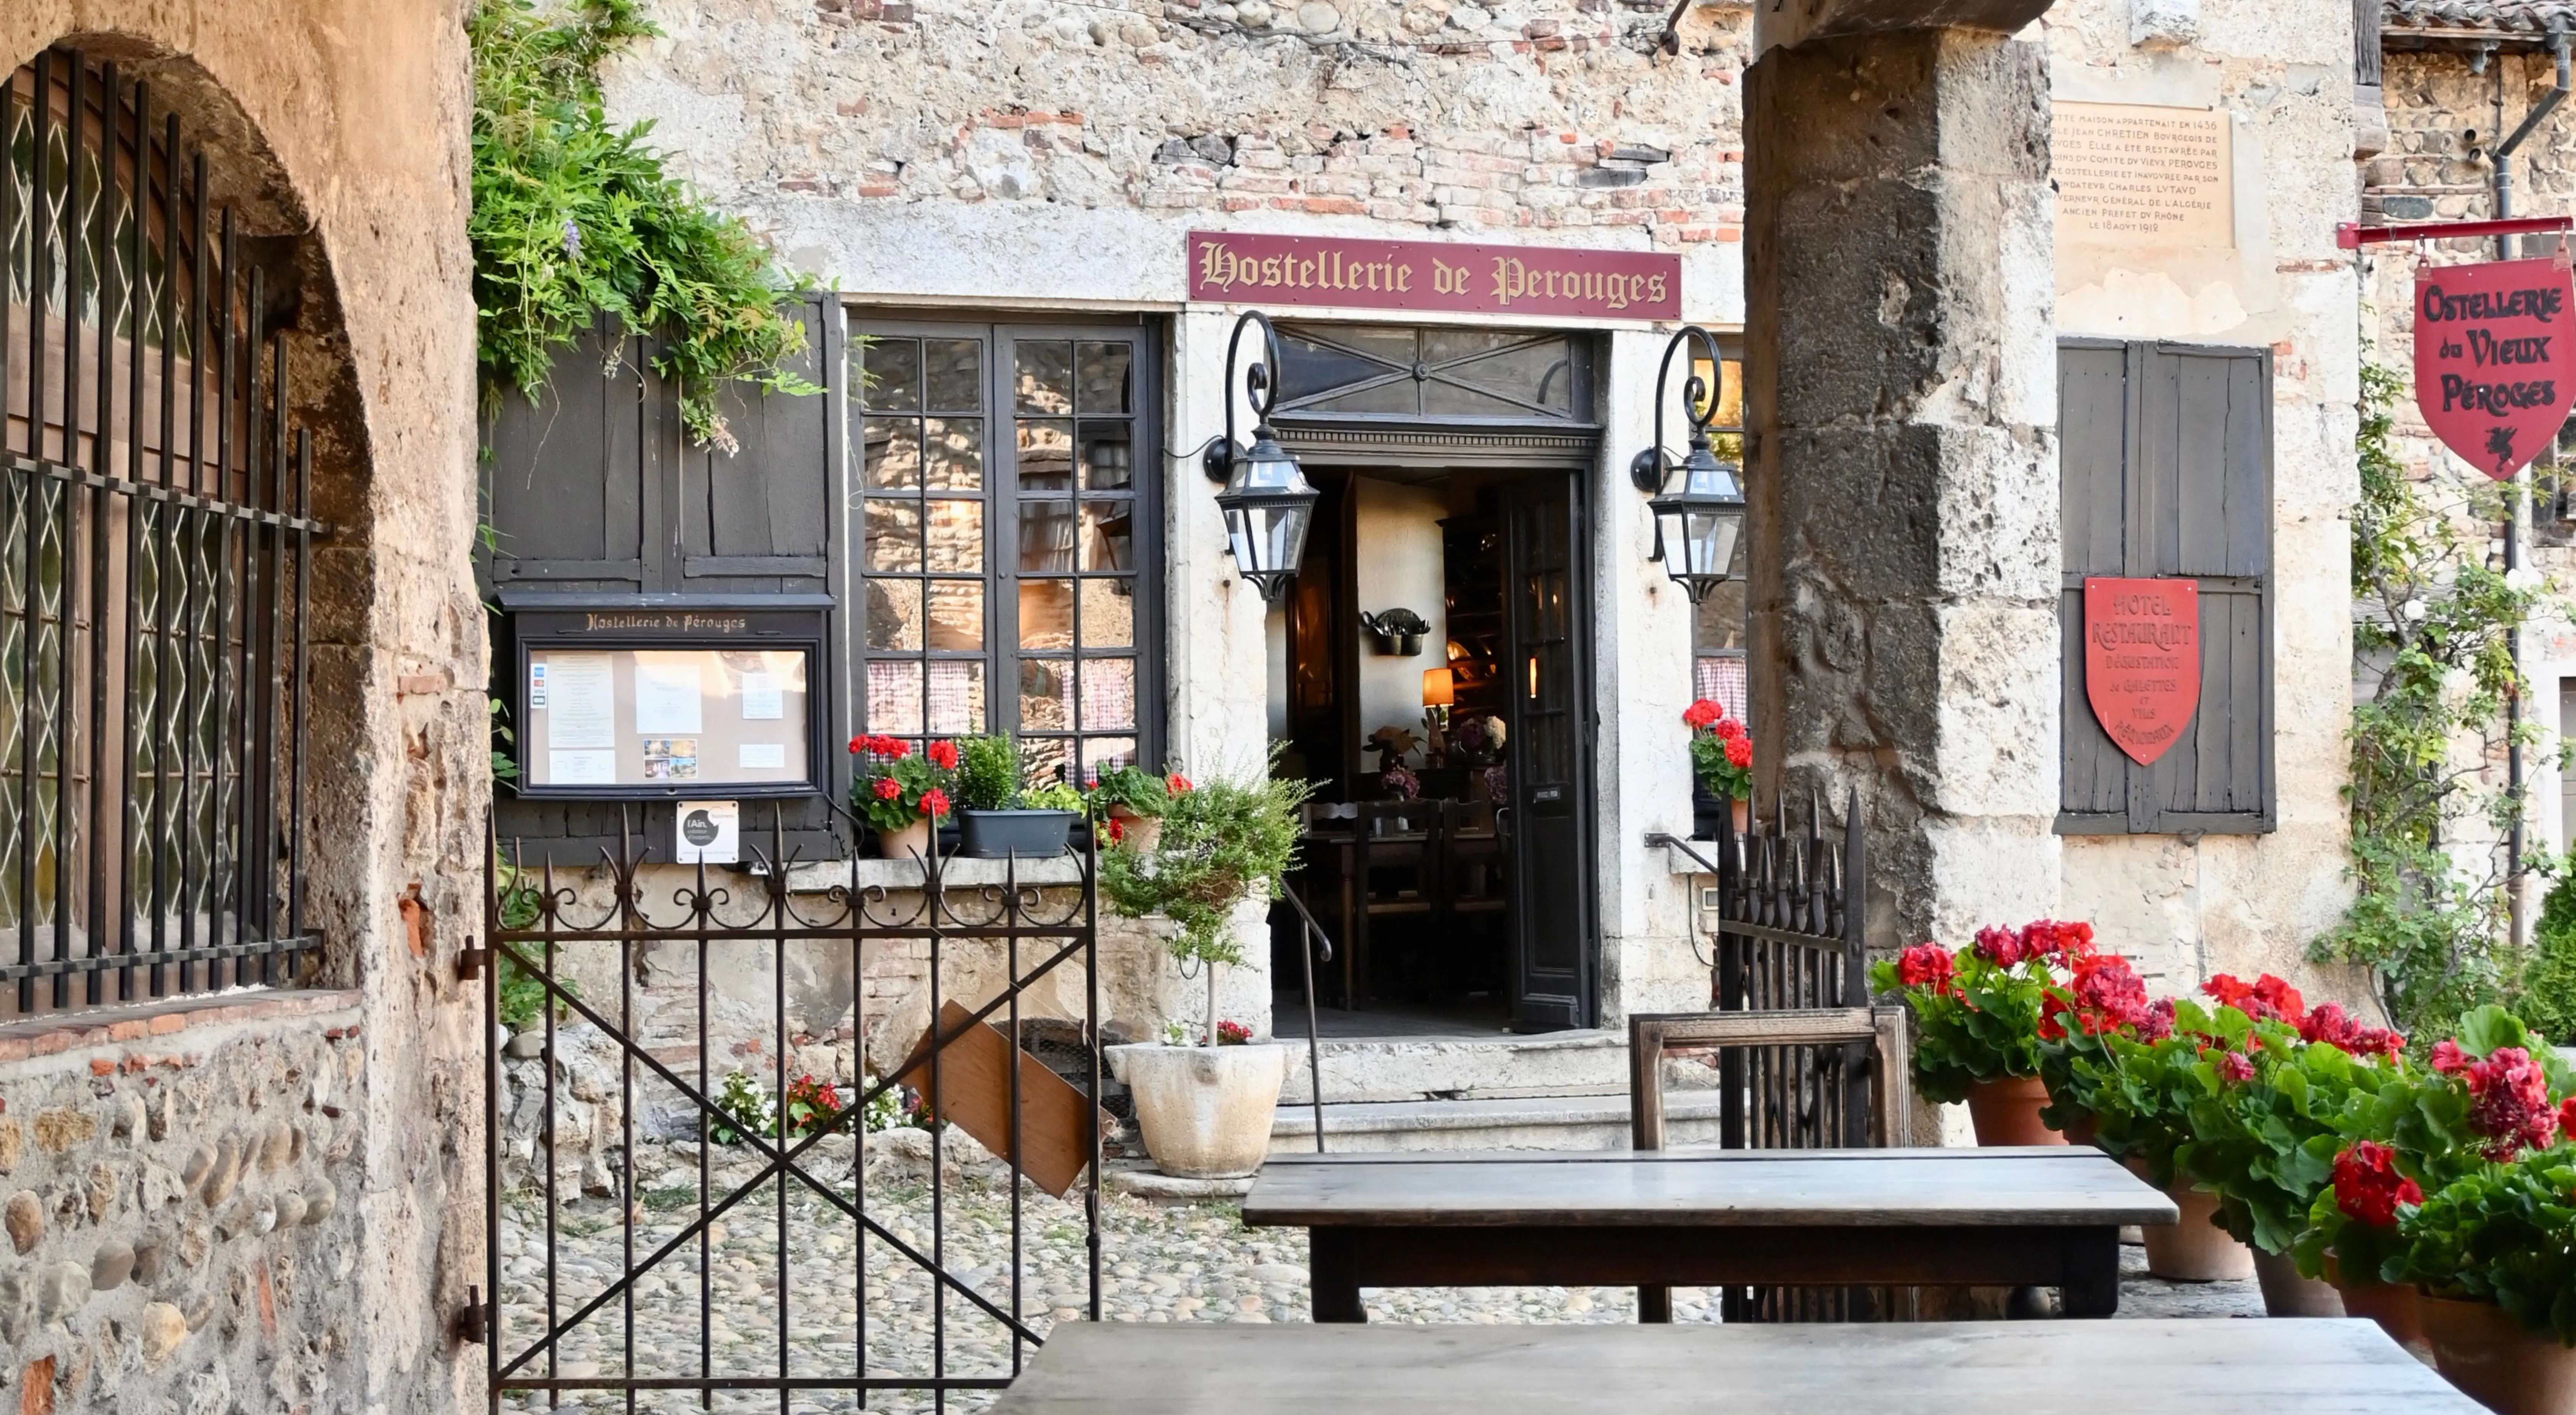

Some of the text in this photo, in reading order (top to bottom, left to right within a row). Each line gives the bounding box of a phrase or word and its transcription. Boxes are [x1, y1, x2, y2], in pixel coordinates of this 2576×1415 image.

[2079, 116, 2113, 124] MAISON
[2116, 118, 2175, 127] APPARTENAIT
[2179, 121, 2190, 129] EN
[2072, 127, 2094, 137] JEAN
[2206, 136, 2217, 144] DE
[2089, 141, 2111, 150] ELLE
[2200, 149, 2218, 158] PAR
[2140, 157, 2166, 167] VIEVX
[2065, 168, 2119, 178] OSTELLERIE
[2183, 174, 2201, 184] PAR
[2203, 175, 2218, 183] SON
[2108, 183, 2151, 192] CHARLES
[2157, 185, 2196, 195] LVTAVD
[2063, 208, 2097, 216] ANCIEN
[2154, 211, 2185, 221] RHÔNE
[2103, 220, 2112, 230] 18
[2140, 223, 2159, 233] 1912
[1198, 241, 1667, 310] Hostellerie de Perouges
[586, 613, 660, 631] Hostellerie
[666, 616, 679, 628] de
